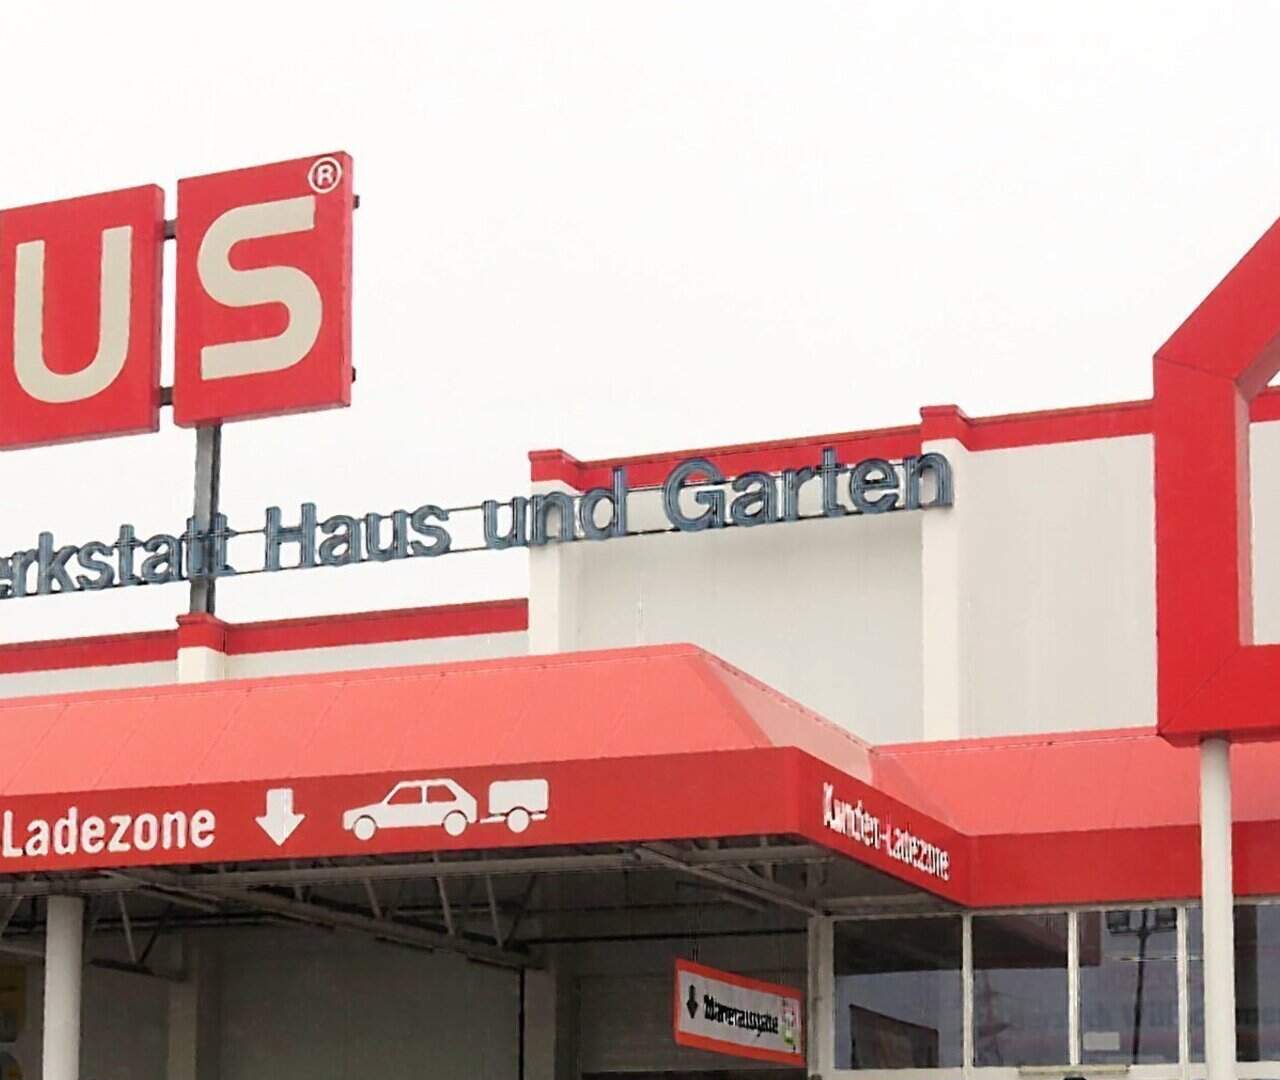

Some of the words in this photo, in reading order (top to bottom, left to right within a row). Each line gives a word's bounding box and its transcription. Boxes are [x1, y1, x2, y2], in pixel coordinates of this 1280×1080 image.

[265, 502, 450, 572] Haus
[482, 467, 628, 547] und
[662, 447, 954, 531] Garten
[823, 782, 950, 881] Kunden-Ladezone
